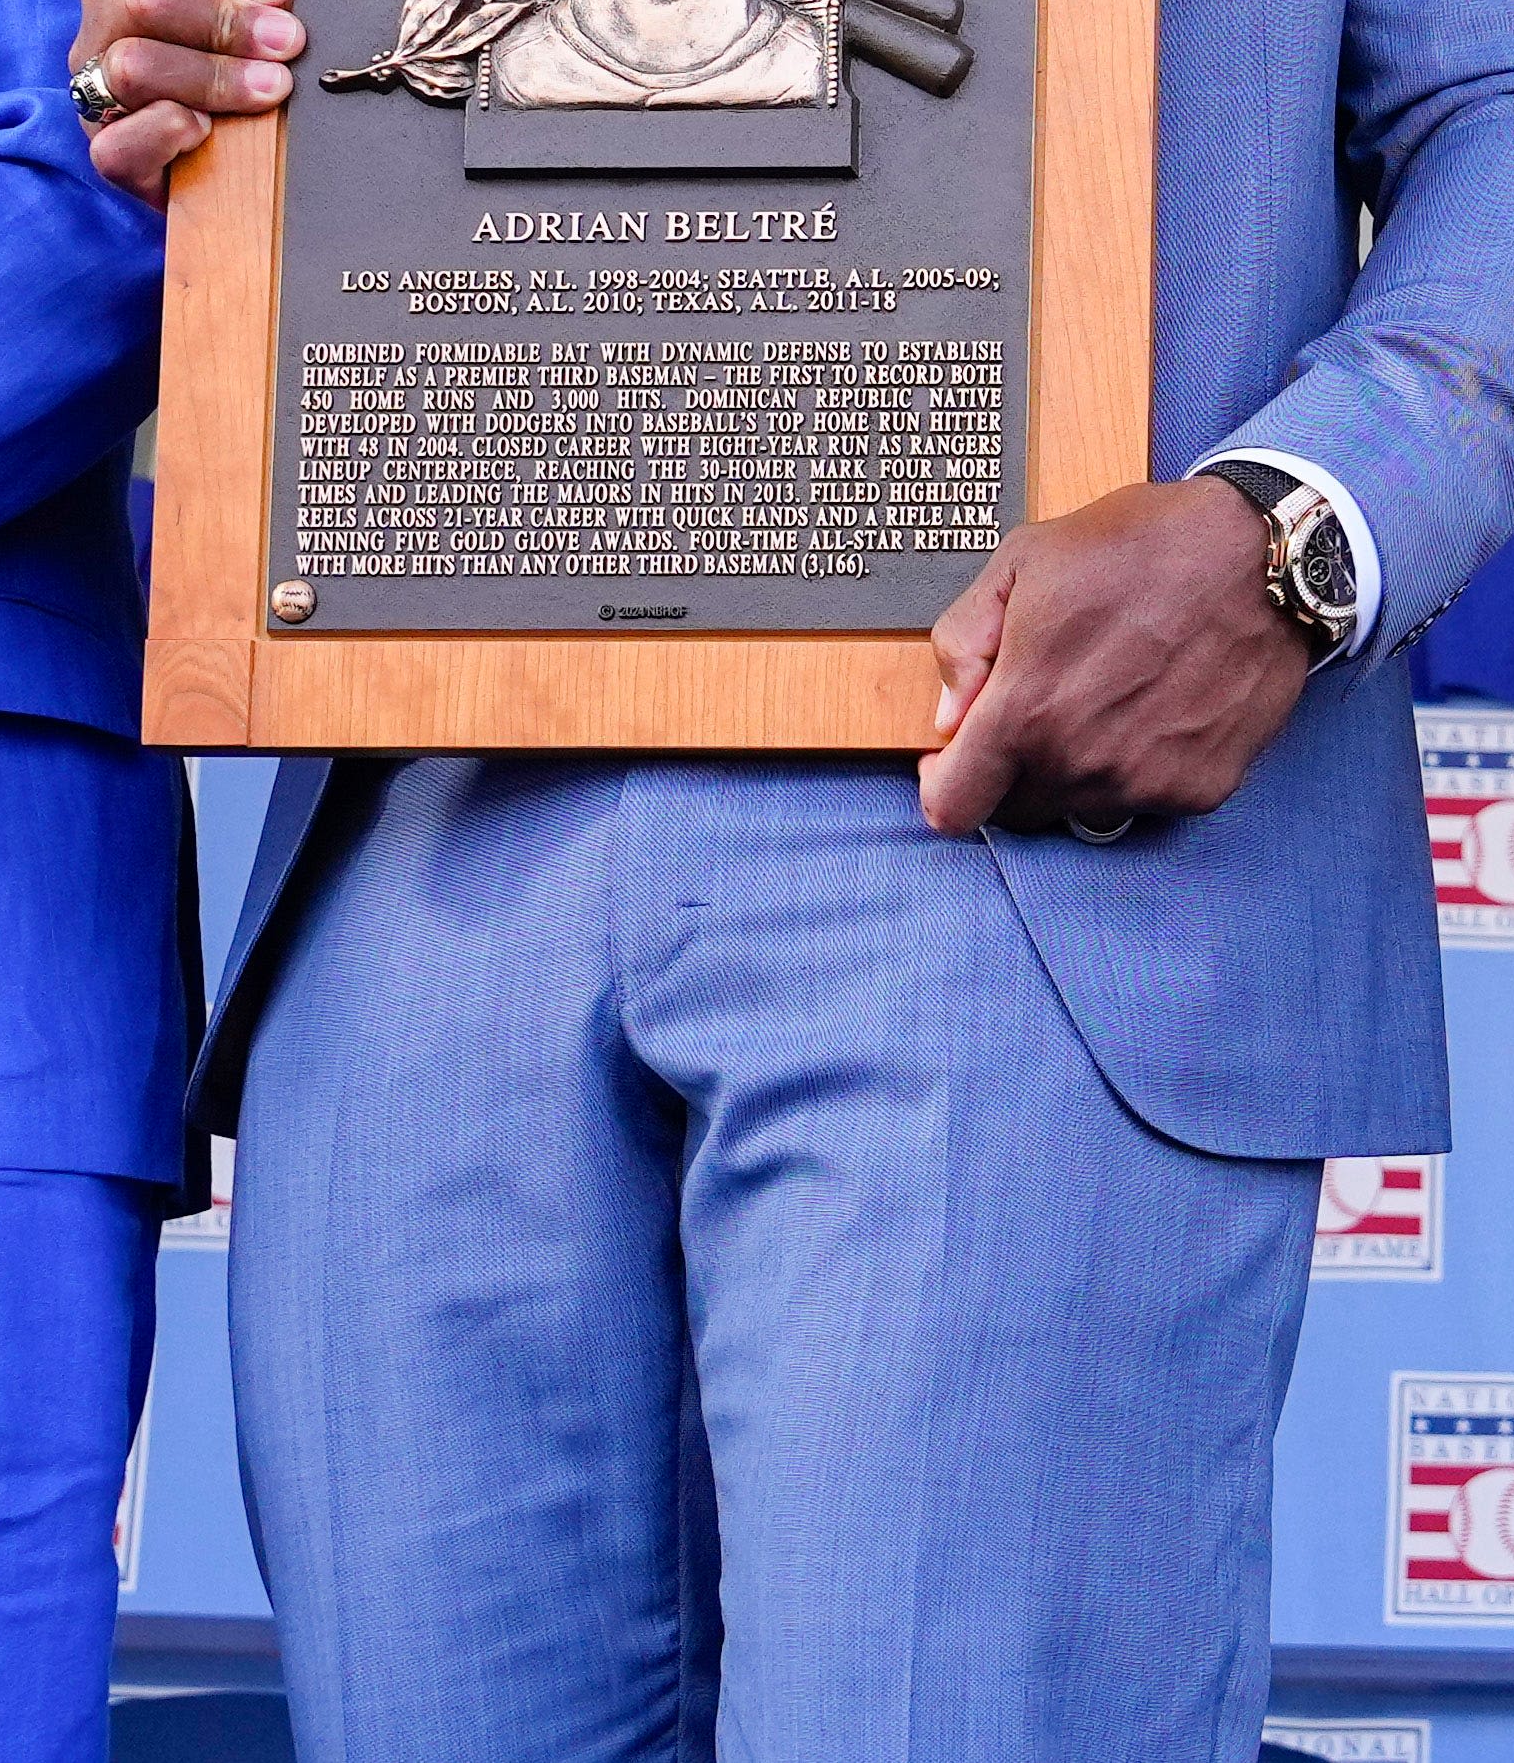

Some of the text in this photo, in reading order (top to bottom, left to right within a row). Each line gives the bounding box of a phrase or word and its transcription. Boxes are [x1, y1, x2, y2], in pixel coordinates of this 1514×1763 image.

[471, 201, 837, 241] ADRIAN BELTRÉ
[341, 268, 999, 293] LOS ANGELES, N.L. 1998-2004; SEATTLE, A.L. 2005-09;
[408, 290, 896, 315] BOSTON, A.L. 2010; TEXAS, A.L. 2011-18
[302, 340, 1003, 364] COMBINED FORMIDABLE BAT WITH DYNAMIC DEFENSE TO ESTABLISH
[296, 528, 1000, 551] WINNING FIVE GOLD GLOVE AWARDS. FOUR-TIME ALL-STAR RETIRED
[1440, 908, 1485, 927] ALL
[1403, 1583, 1471, 1604] HALL
